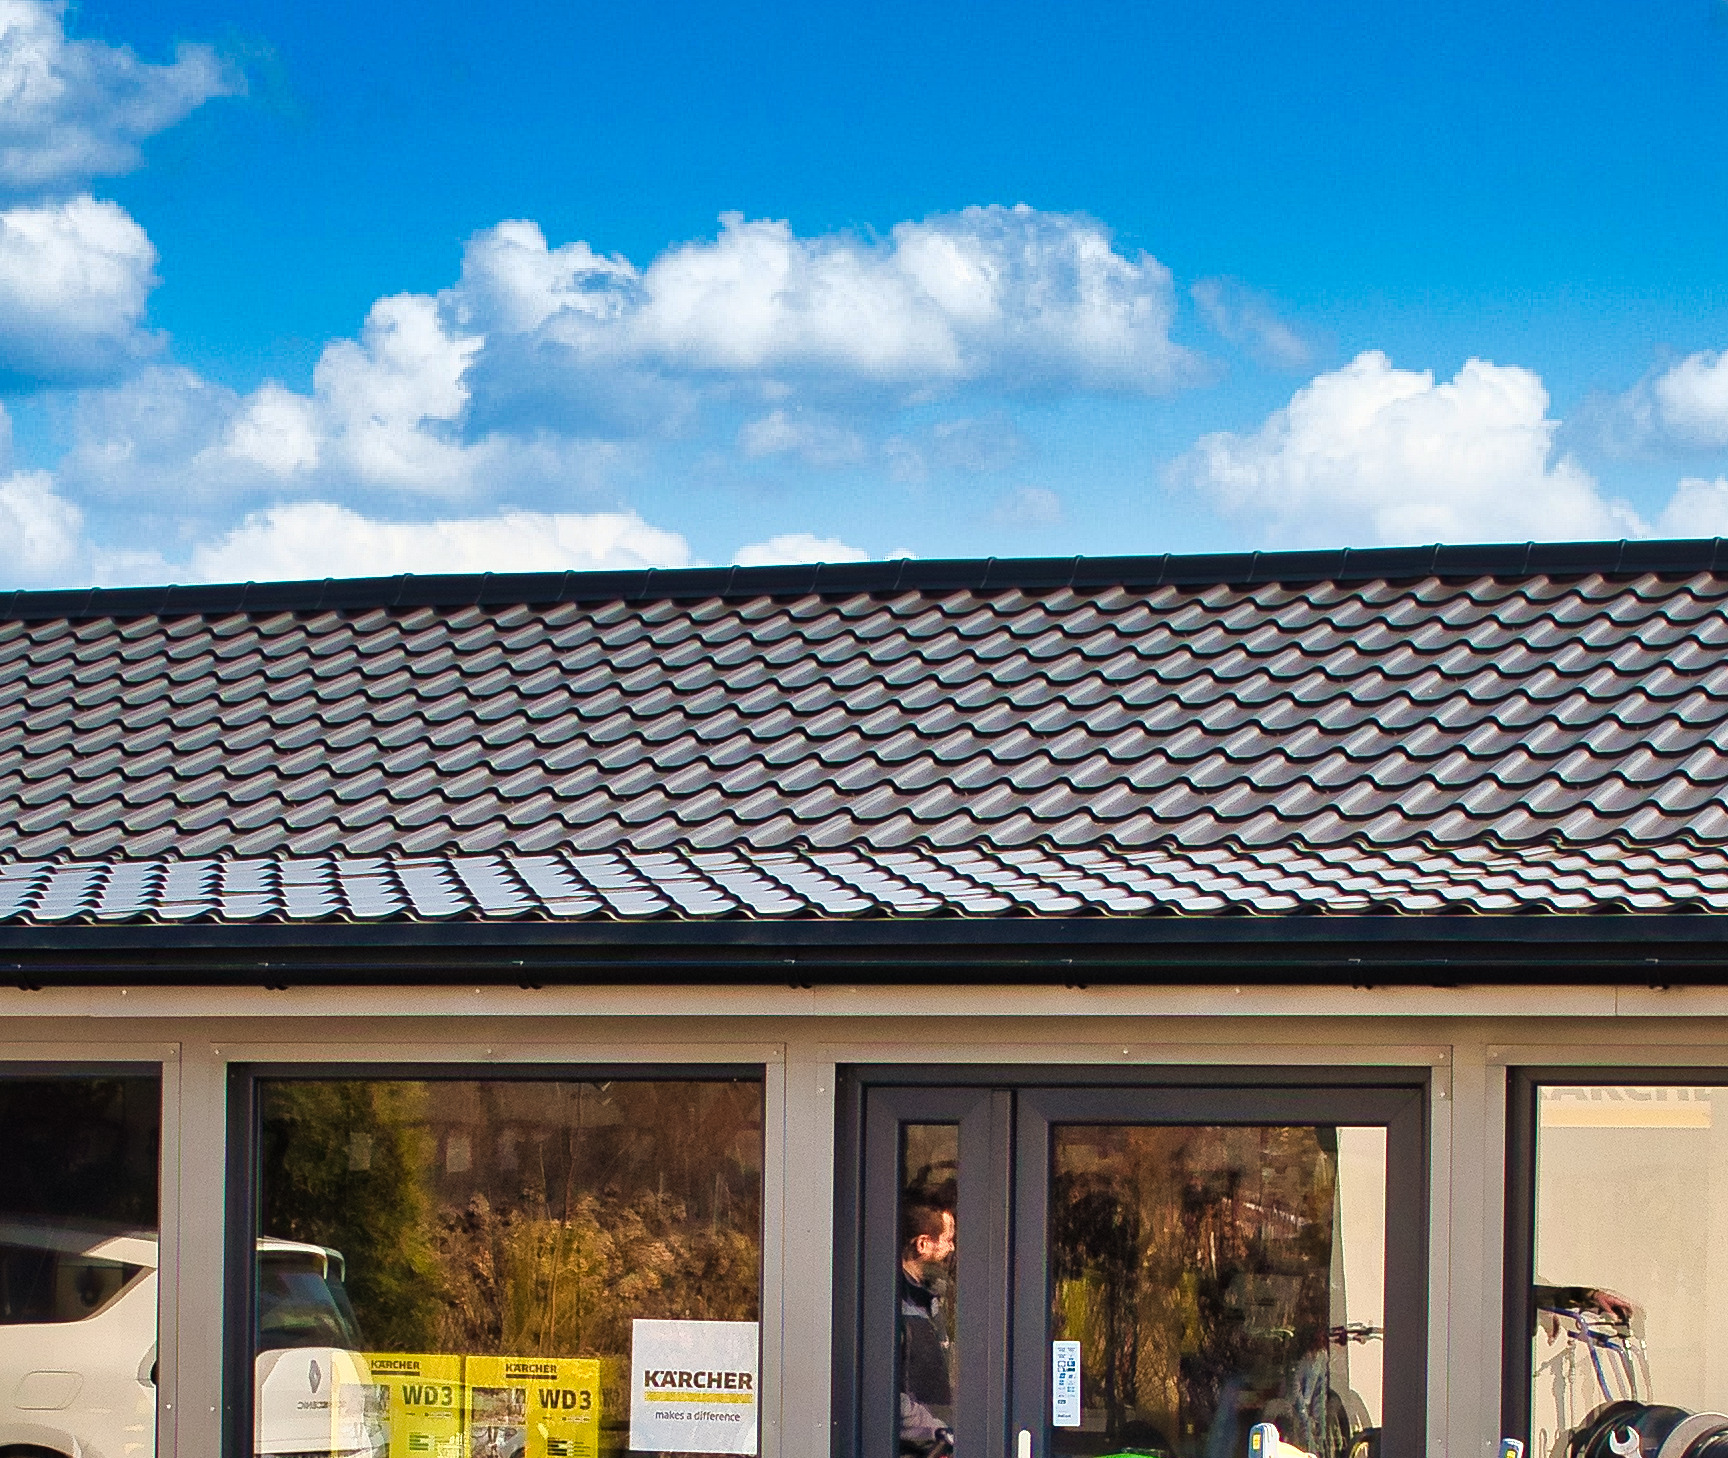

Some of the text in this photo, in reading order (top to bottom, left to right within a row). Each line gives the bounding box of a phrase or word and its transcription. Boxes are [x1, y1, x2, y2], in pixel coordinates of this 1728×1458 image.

[505, 1363, 557, 1374] KÄRCHER
[644, 1369, 753, 1390] KÄRCHER
[655, 1410, 741, 1422] makes a difference
